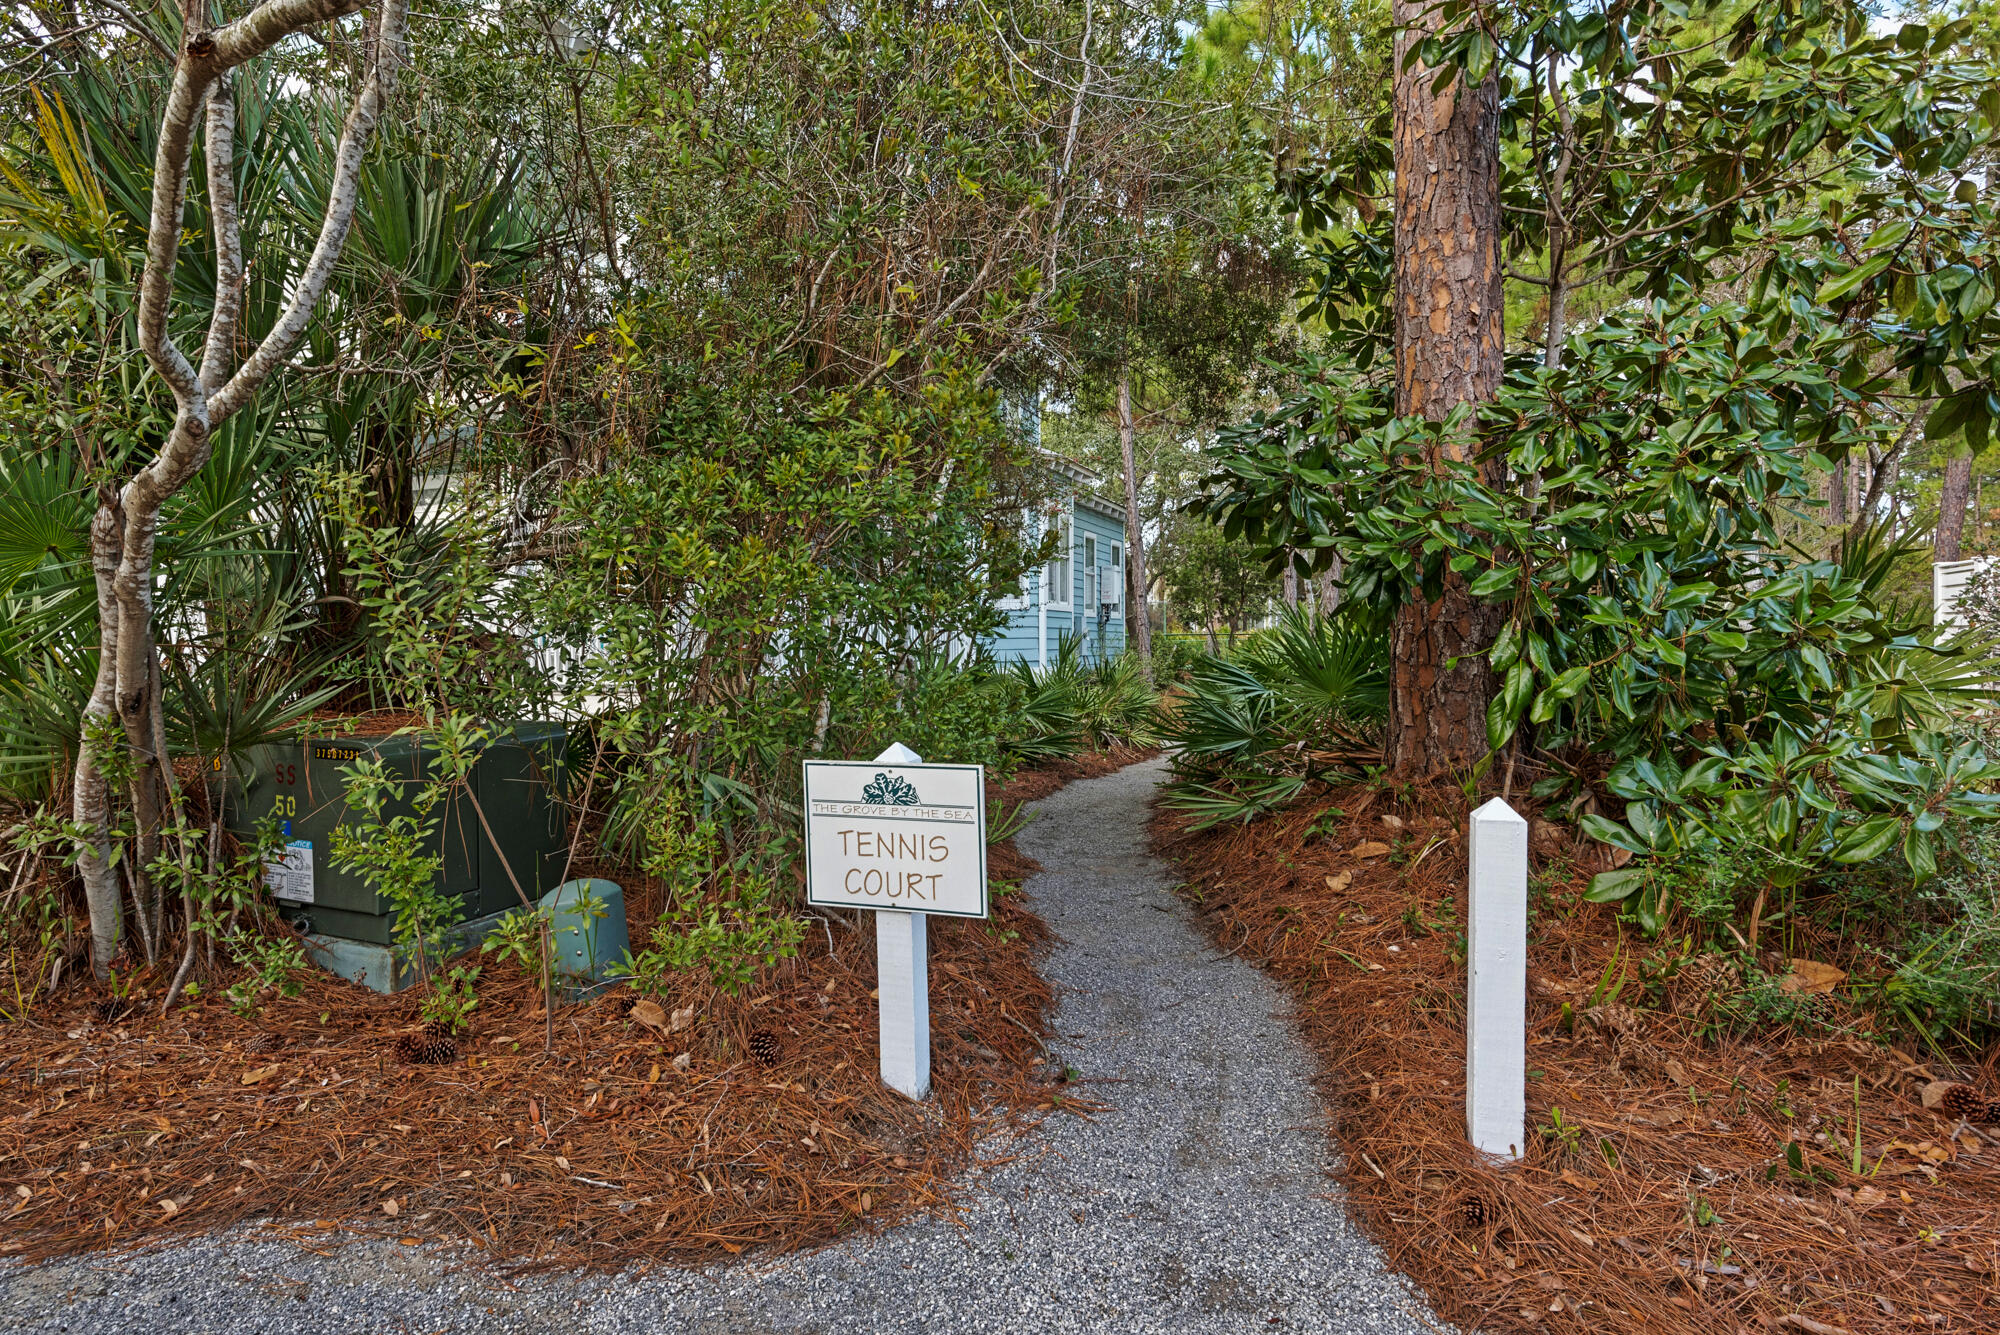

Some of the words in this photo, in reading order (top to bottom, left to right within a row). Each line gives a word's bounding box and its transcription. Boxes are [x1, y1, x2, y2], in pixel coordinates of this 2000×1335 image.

[275, 764, 296, 785] SS
[275, 795, 296, 817] 50
[813, 803, 838, 813] THE
[842, 804, 886, 815] GROVE
[891, 807, 909, 816] BY
[913, 808, 939, 818] THE
[943, 810, 973, 820] SEA
[837, 830, 949, 862] TENNIS
[844, 868, 943, 900] COURT
